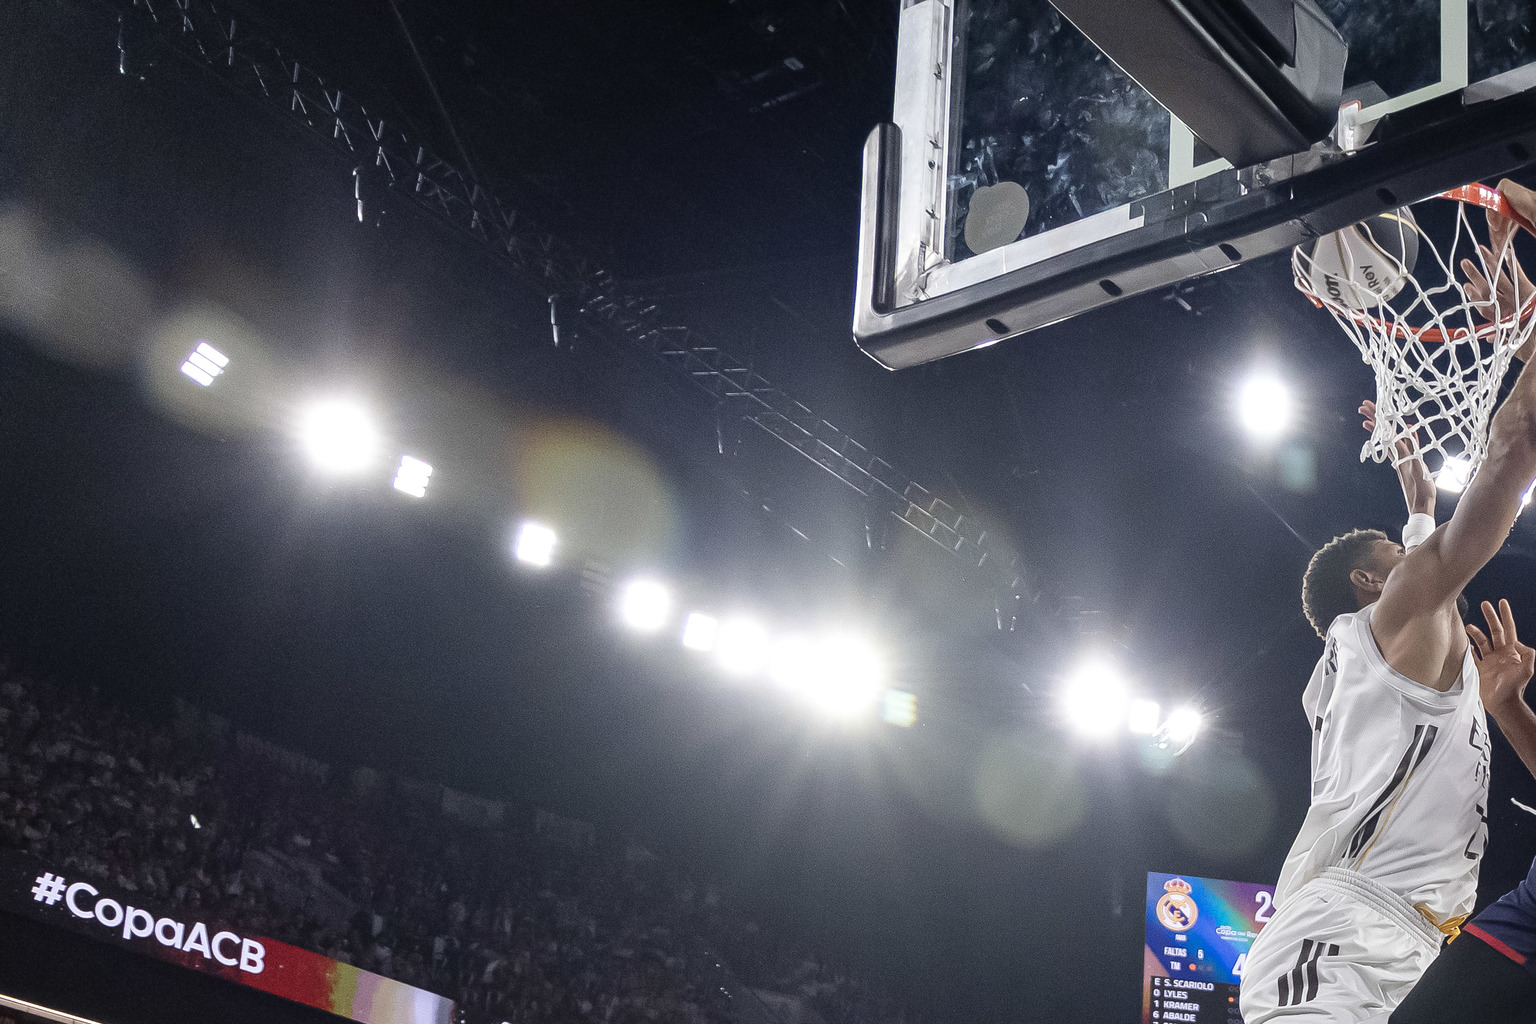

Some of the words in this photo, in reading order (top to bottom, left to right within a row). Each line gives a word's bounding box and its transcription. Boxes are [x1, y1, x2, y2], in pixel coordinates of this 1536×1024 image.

[1255, 891, 1271, 923] 2
[31, 872, 266, 975] #CopaACB
[1164, 946, 1188, 958] FALTAS
[1232, 953, 1247, 976] 4
[1154, 977, 1161, 986] E
[1164, 978, 1172, 987] S.
[1173, 979, 1215, 991] SCARIOLO
[1153, 988, 1160, 997] 0
[1163, 989, 1188, 1000] LYLES
[1153, 999, 1159, 1008] 1
[1163, 1000, 1200, 1012] KRAMER
[1152, 1010, 1159, 1019] 6
[1162, 1011, 1197, 1022] ABALDE
